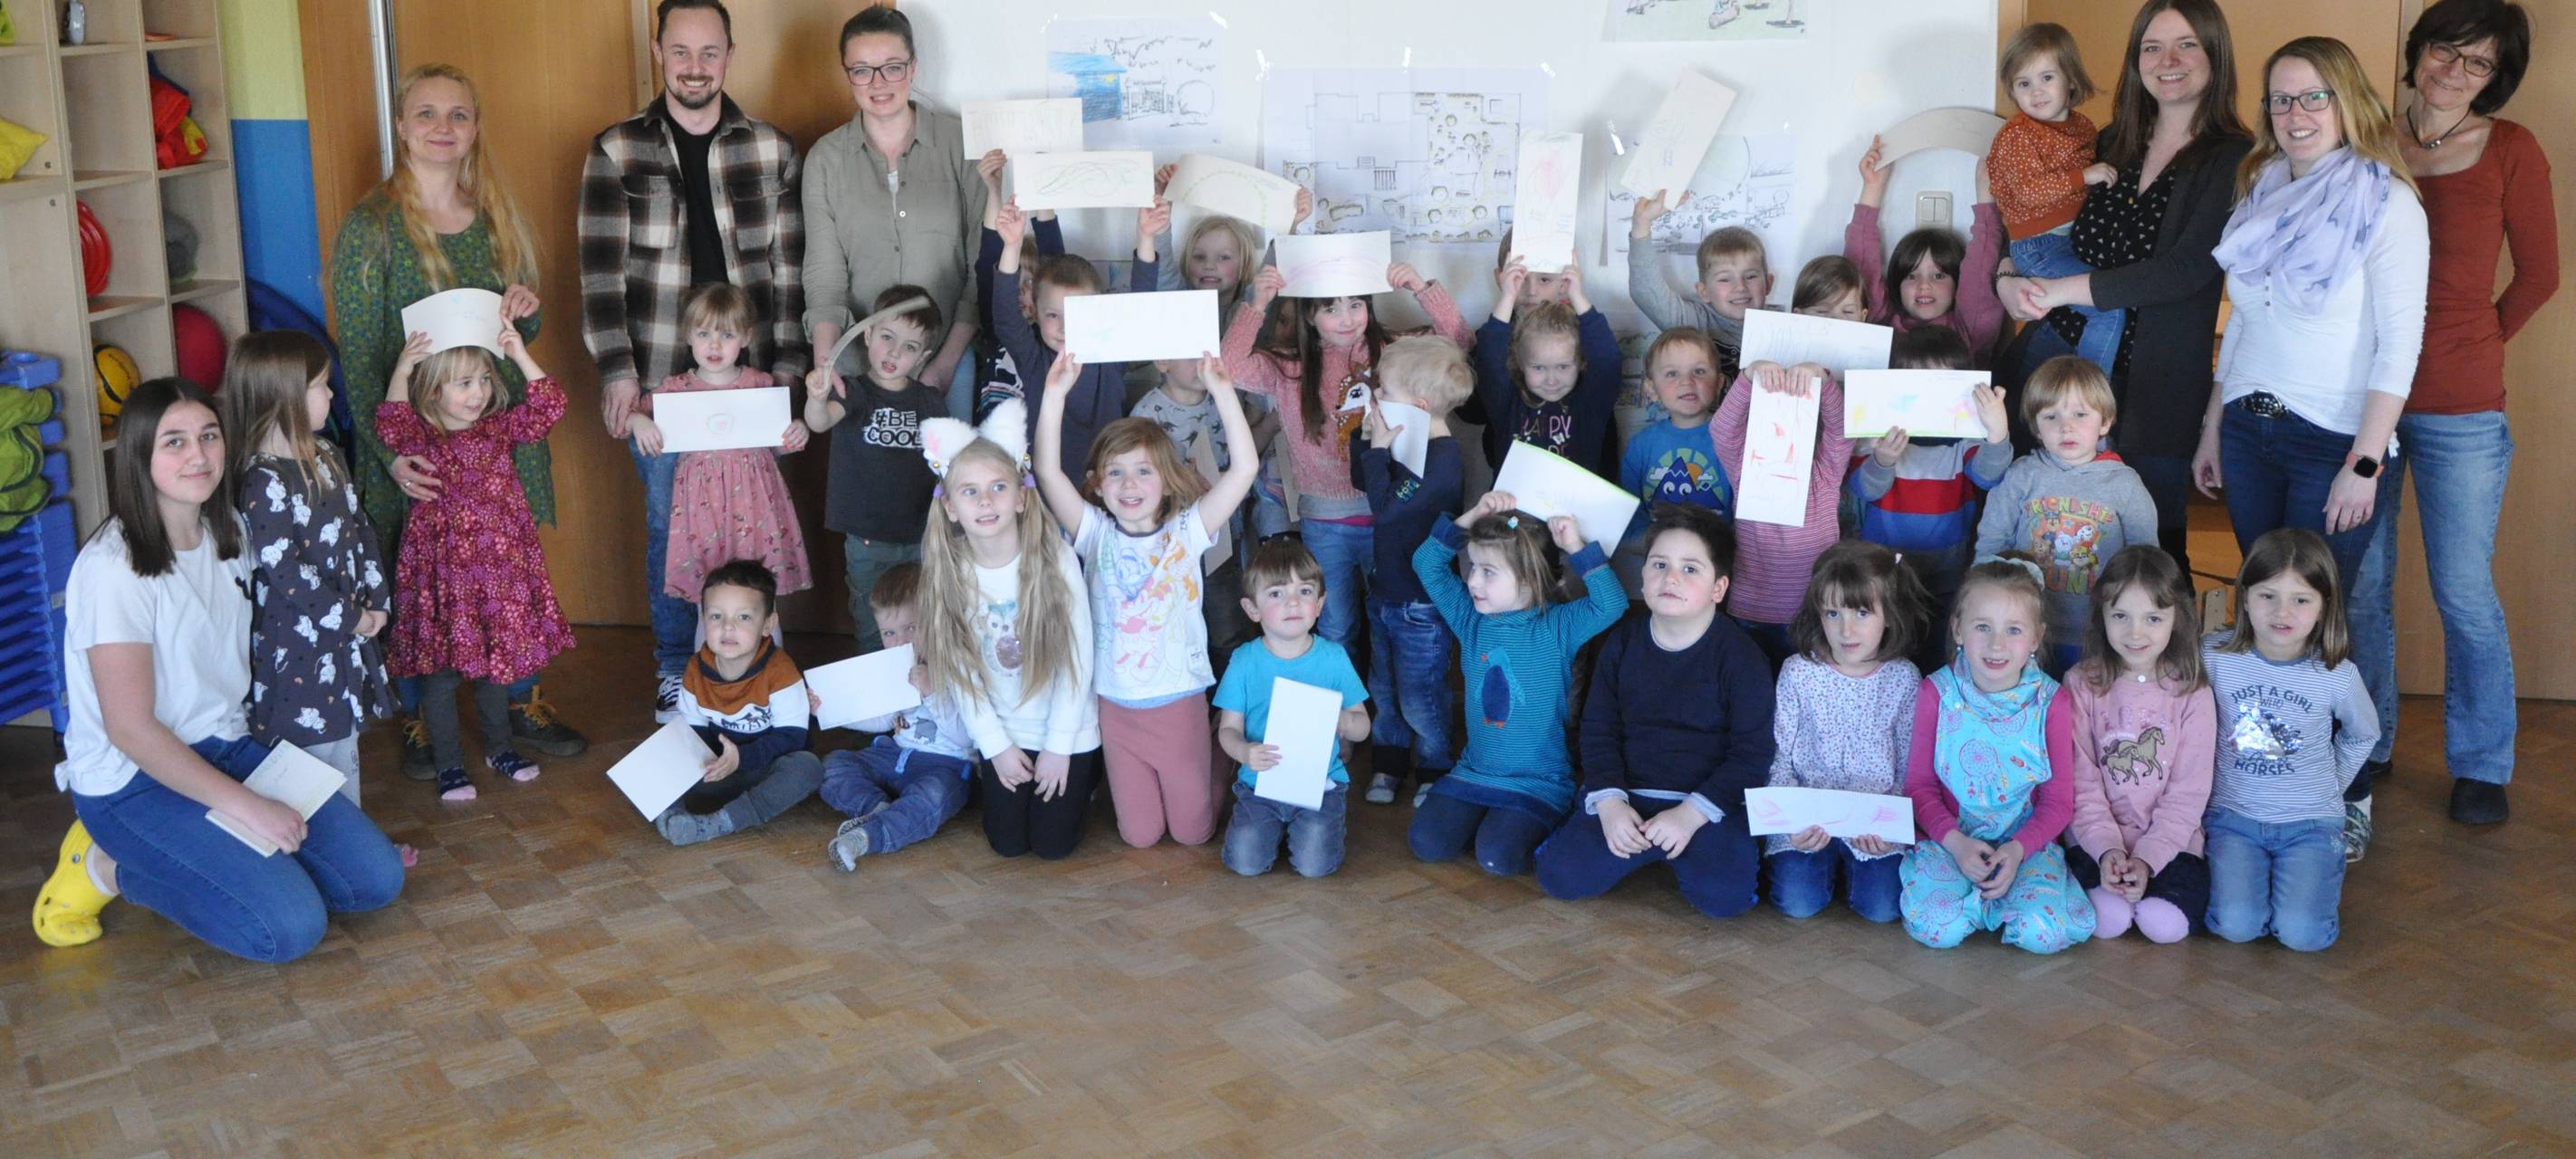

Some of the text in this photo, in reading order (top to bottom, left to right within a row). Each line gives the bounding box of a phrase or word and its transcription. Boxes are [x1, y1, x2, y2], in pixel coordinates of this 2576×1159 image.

[876, 409, 917, 427] #BE
[867, 426, 922, 445] COOL
[2231, 685, 2312, 714] JUST A GIRL
[2234, 759, 2295, 775] HORSES
